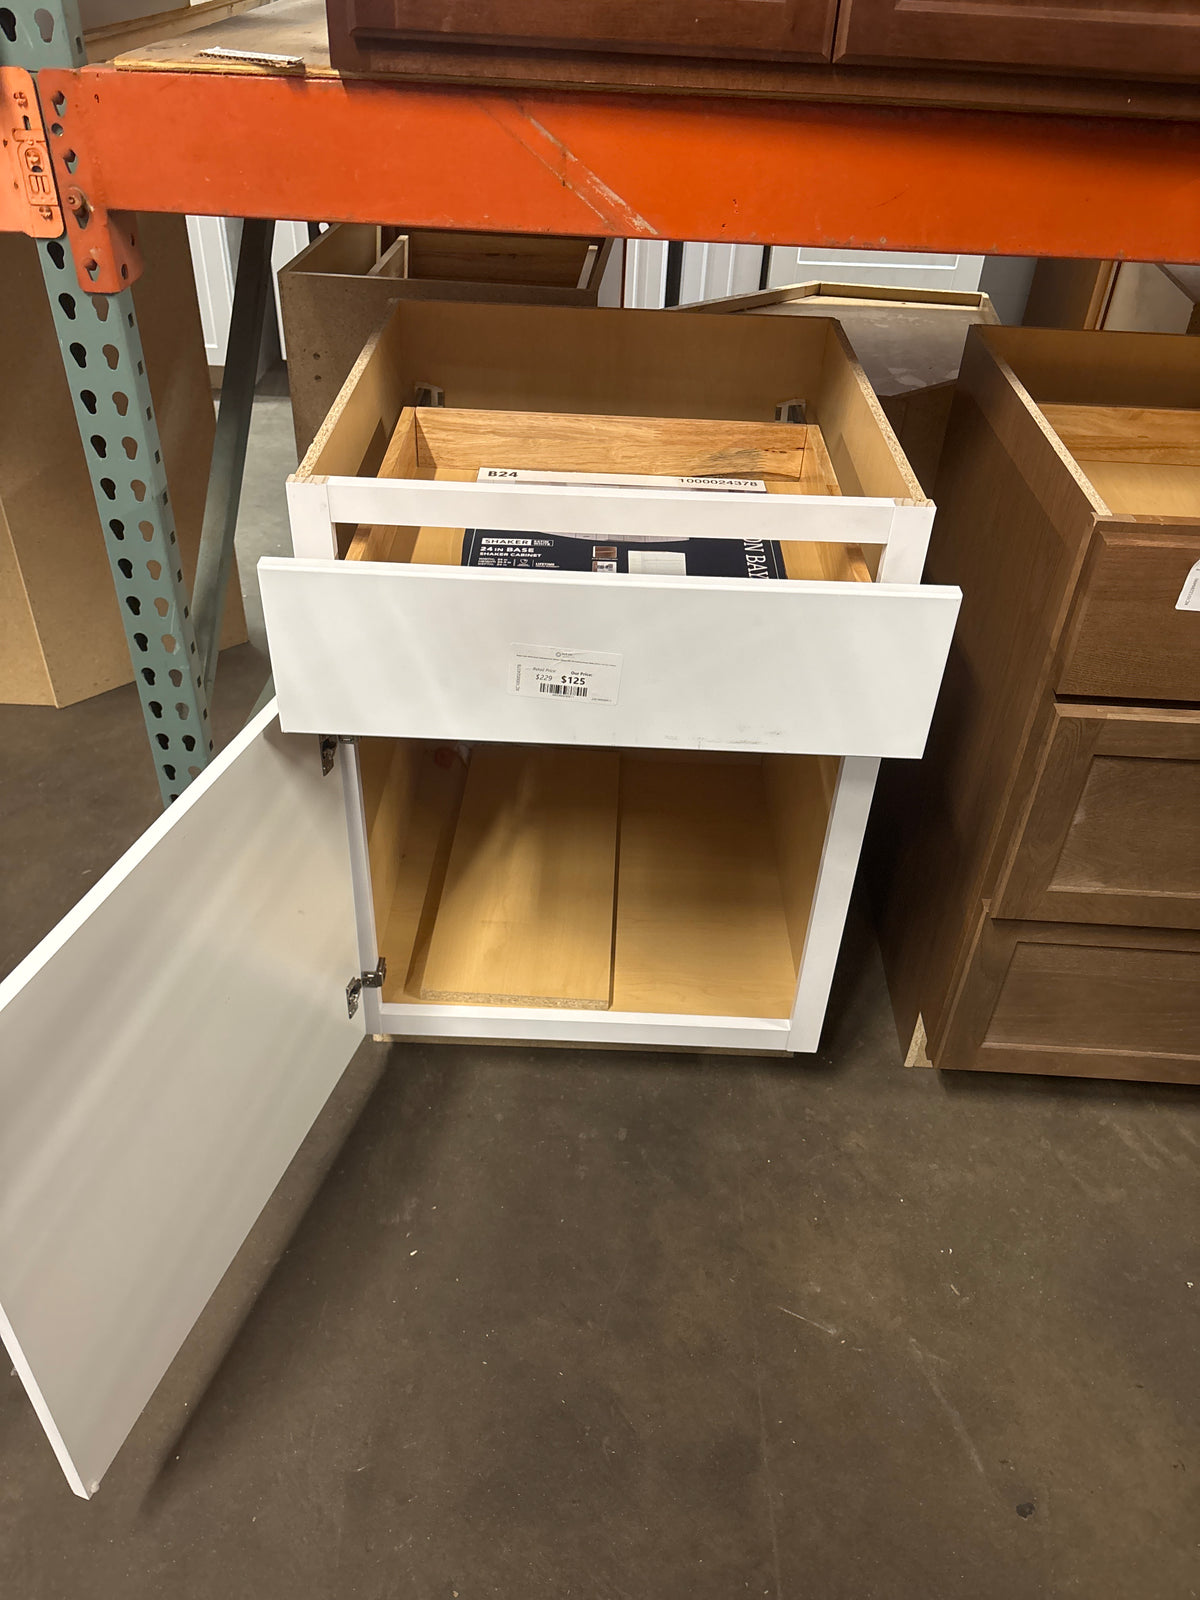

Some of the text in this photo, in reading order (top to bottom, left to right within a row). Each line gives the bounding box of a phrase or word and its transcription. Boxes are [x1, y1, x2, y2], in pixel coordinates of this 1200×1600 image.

[680, 478, 758, 487] 1000024378
[535, 674, 553, 682] $229
[561, 675, 586, 686] $125
